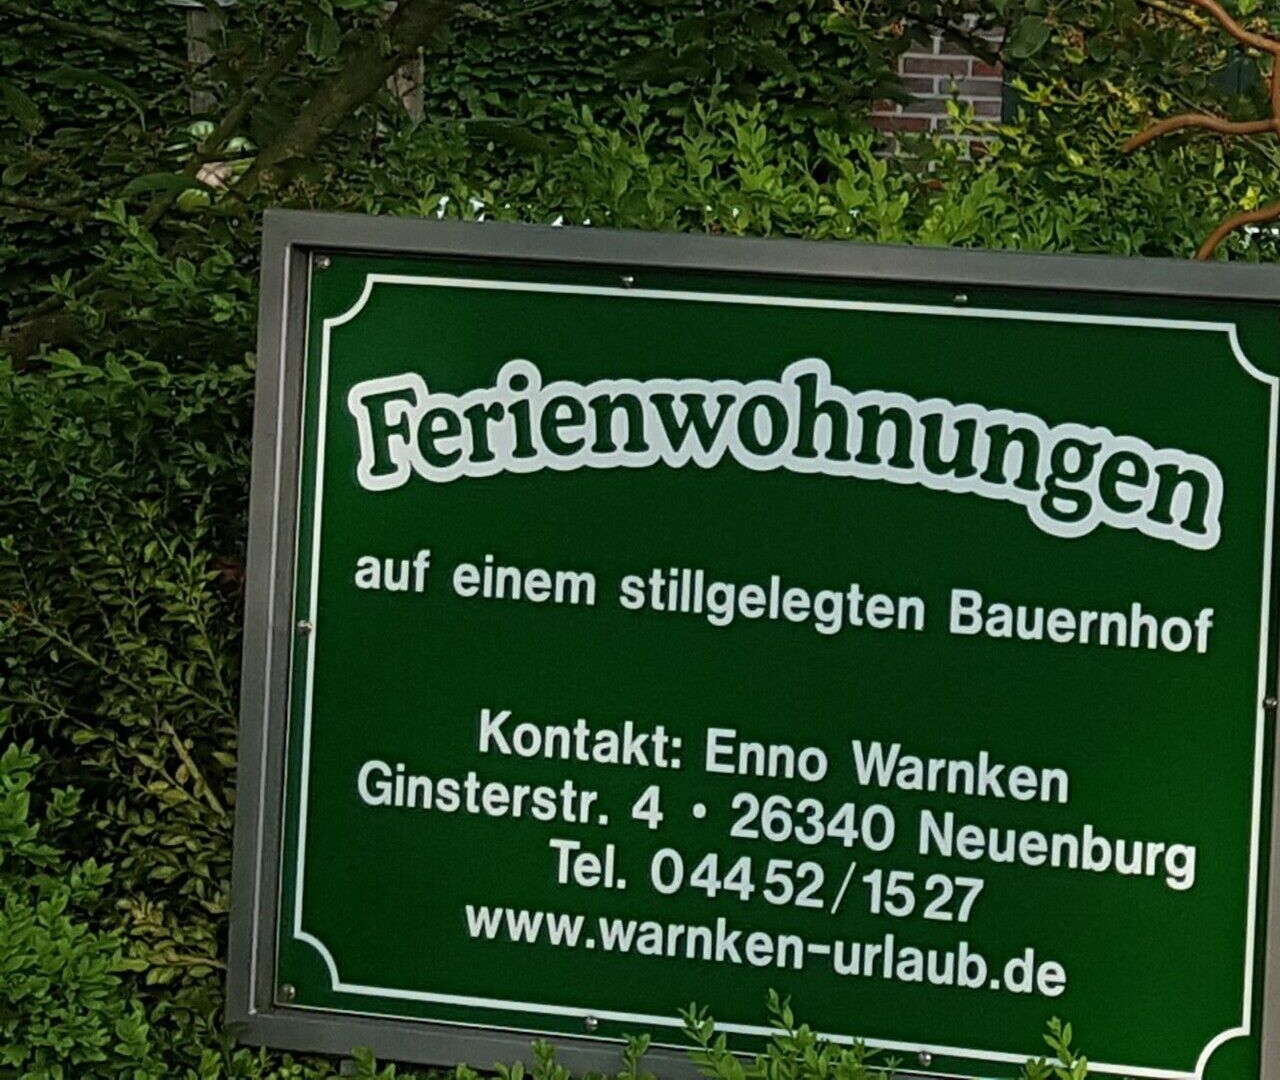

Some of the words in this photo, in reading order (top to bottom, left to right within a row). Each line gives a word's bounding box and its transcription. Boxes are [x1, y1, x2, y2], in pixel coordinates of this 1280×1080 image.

[348, 358, 1223, 550] Ferienwohnungen
[354, 549, 431, 593] auf
[452, 554, 596, 606] einem
[619, 567, 925, 635] stillgelegten
[949, 588, 1214, 654] Bauernhof
[479, 708, 682, 769] Kontakt:
[705, 727, 828, 782] Enno
[852, 739, 1069, 804] Warnken
[357, 759, 609, 826] Ginsterstr.
[631, 785, 664, 830] 4
[730, 792, 895, 852] 26340
[919, 809, 1196, 891] Neuenburg
[549, 838, 627, 890] Tel.
[650, 847, 984, 922] 04452/1527
[465, 904, 1067, 997] www.warnken-urlaub.de
